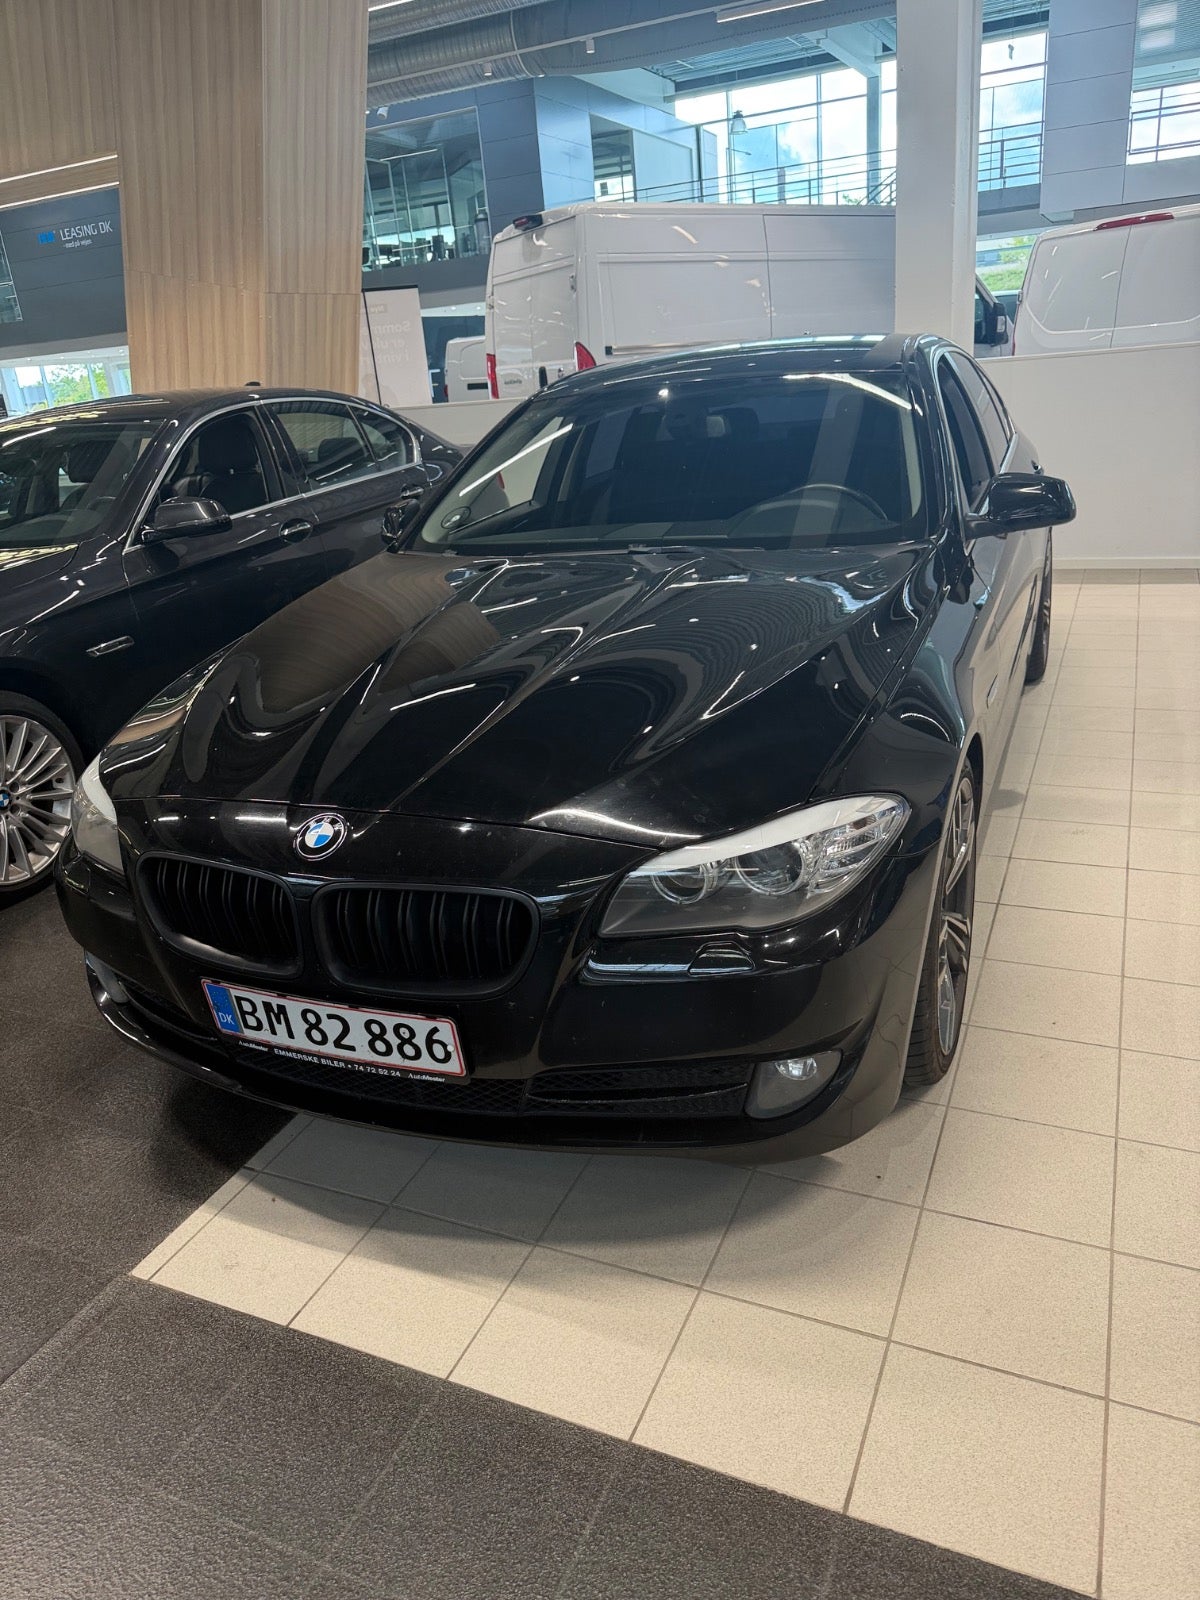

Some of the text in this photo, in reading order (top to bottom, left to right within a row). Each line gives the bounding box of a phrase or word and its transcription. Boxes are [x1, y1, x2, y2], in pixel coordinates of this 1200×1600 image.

[59, 220, 113, 240] LEASING DK
[217, 1011, 235, 1026] DK
[233, 995, 453, 1064] BM 82 886
[274, 1048, 320, 1064] EMMERSKE
[320, 1057, 346, 1069] BILER
[354, 1064, 365, 1072] 74
